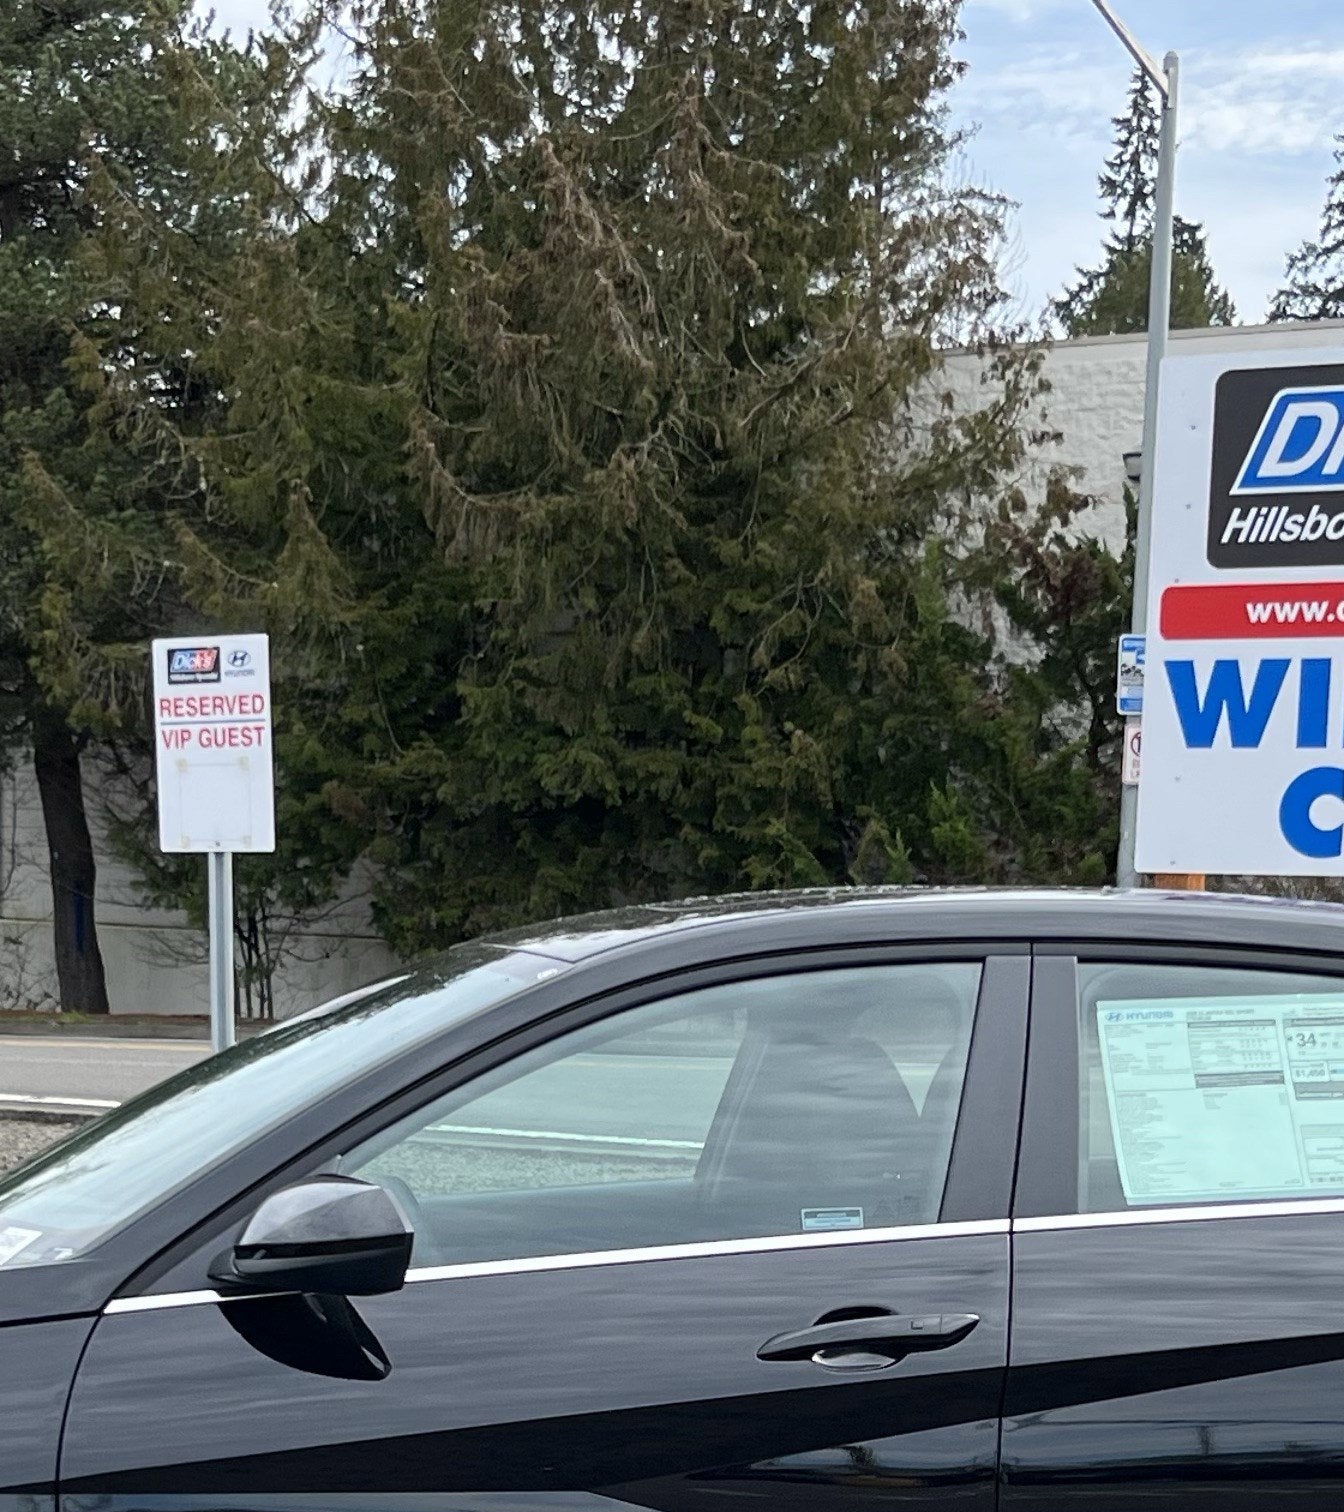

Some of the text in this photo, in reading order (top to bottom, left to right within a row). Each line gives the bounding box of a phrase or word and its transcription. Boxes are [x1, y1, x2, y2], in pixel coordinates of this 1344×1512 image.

[158, 694, 266, 718] RESERVED
[161, 726, 266, 751] VIP GUEST
